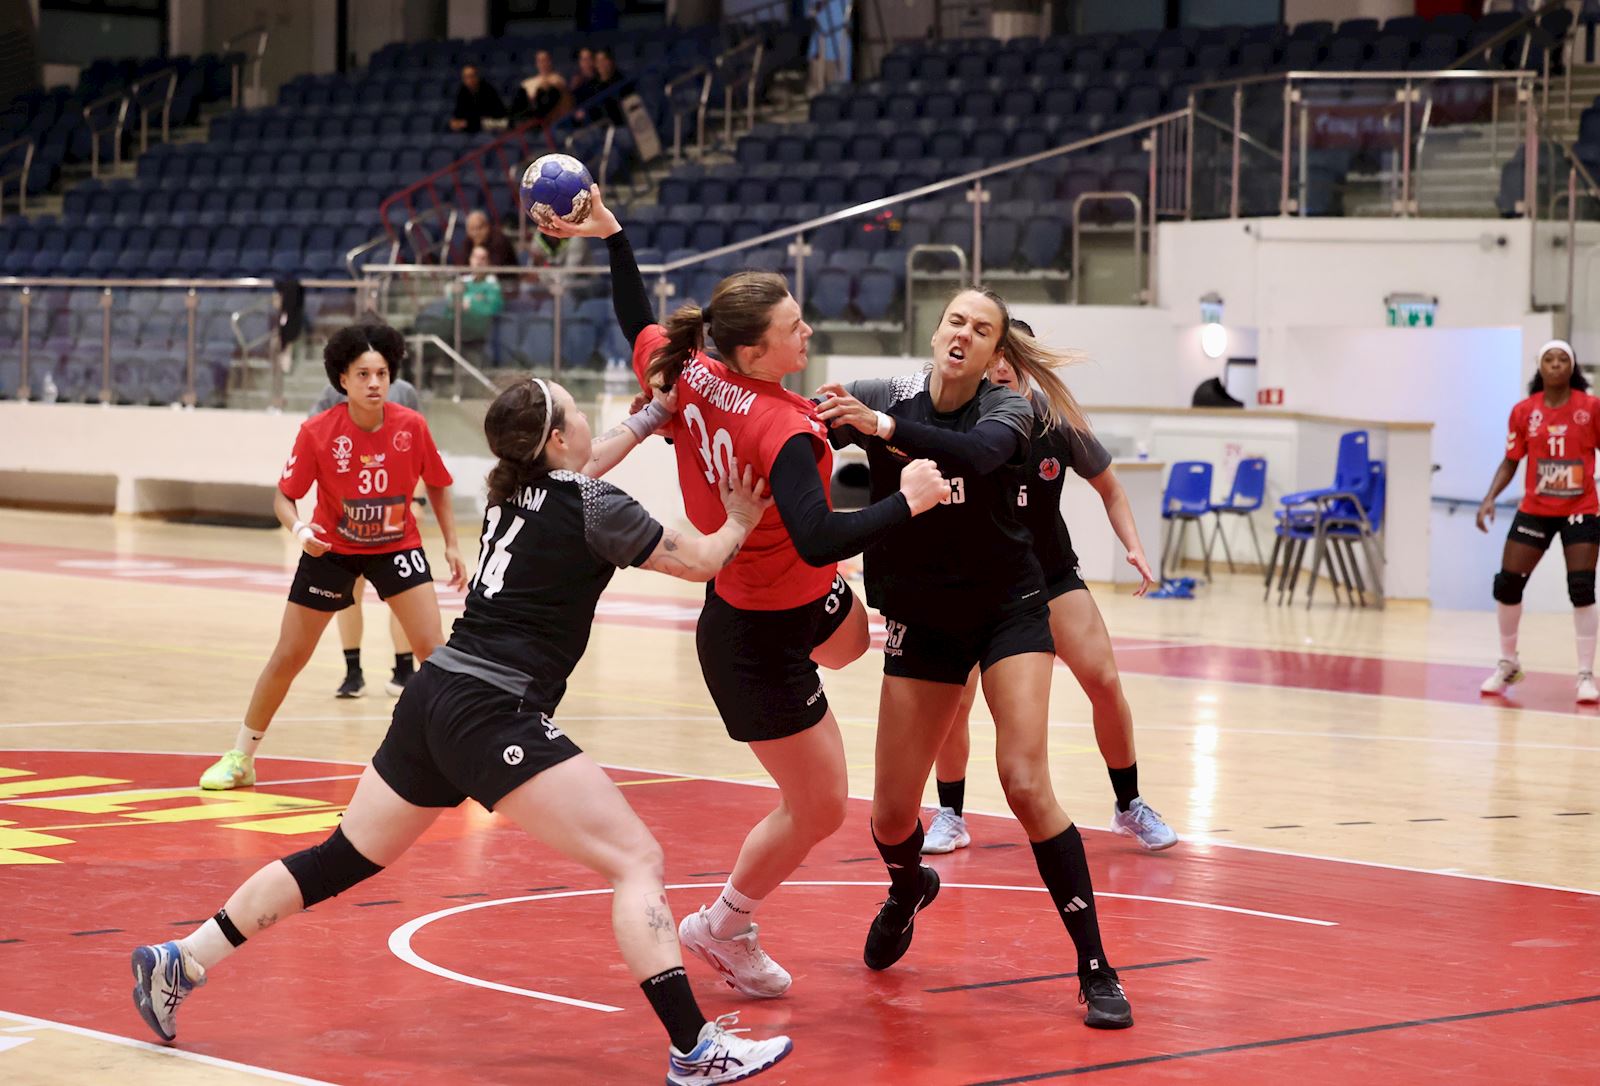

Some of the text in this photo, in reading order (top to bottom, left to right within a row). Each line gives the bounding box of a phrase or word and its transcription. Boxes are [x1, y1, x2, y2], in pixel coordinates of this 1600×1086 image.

[1547, 436, 1566, 457] 11
[358, 468, 389, 495] 30
[394, 549, 427, 579] 30
[473, 505, 525, 600] 14
